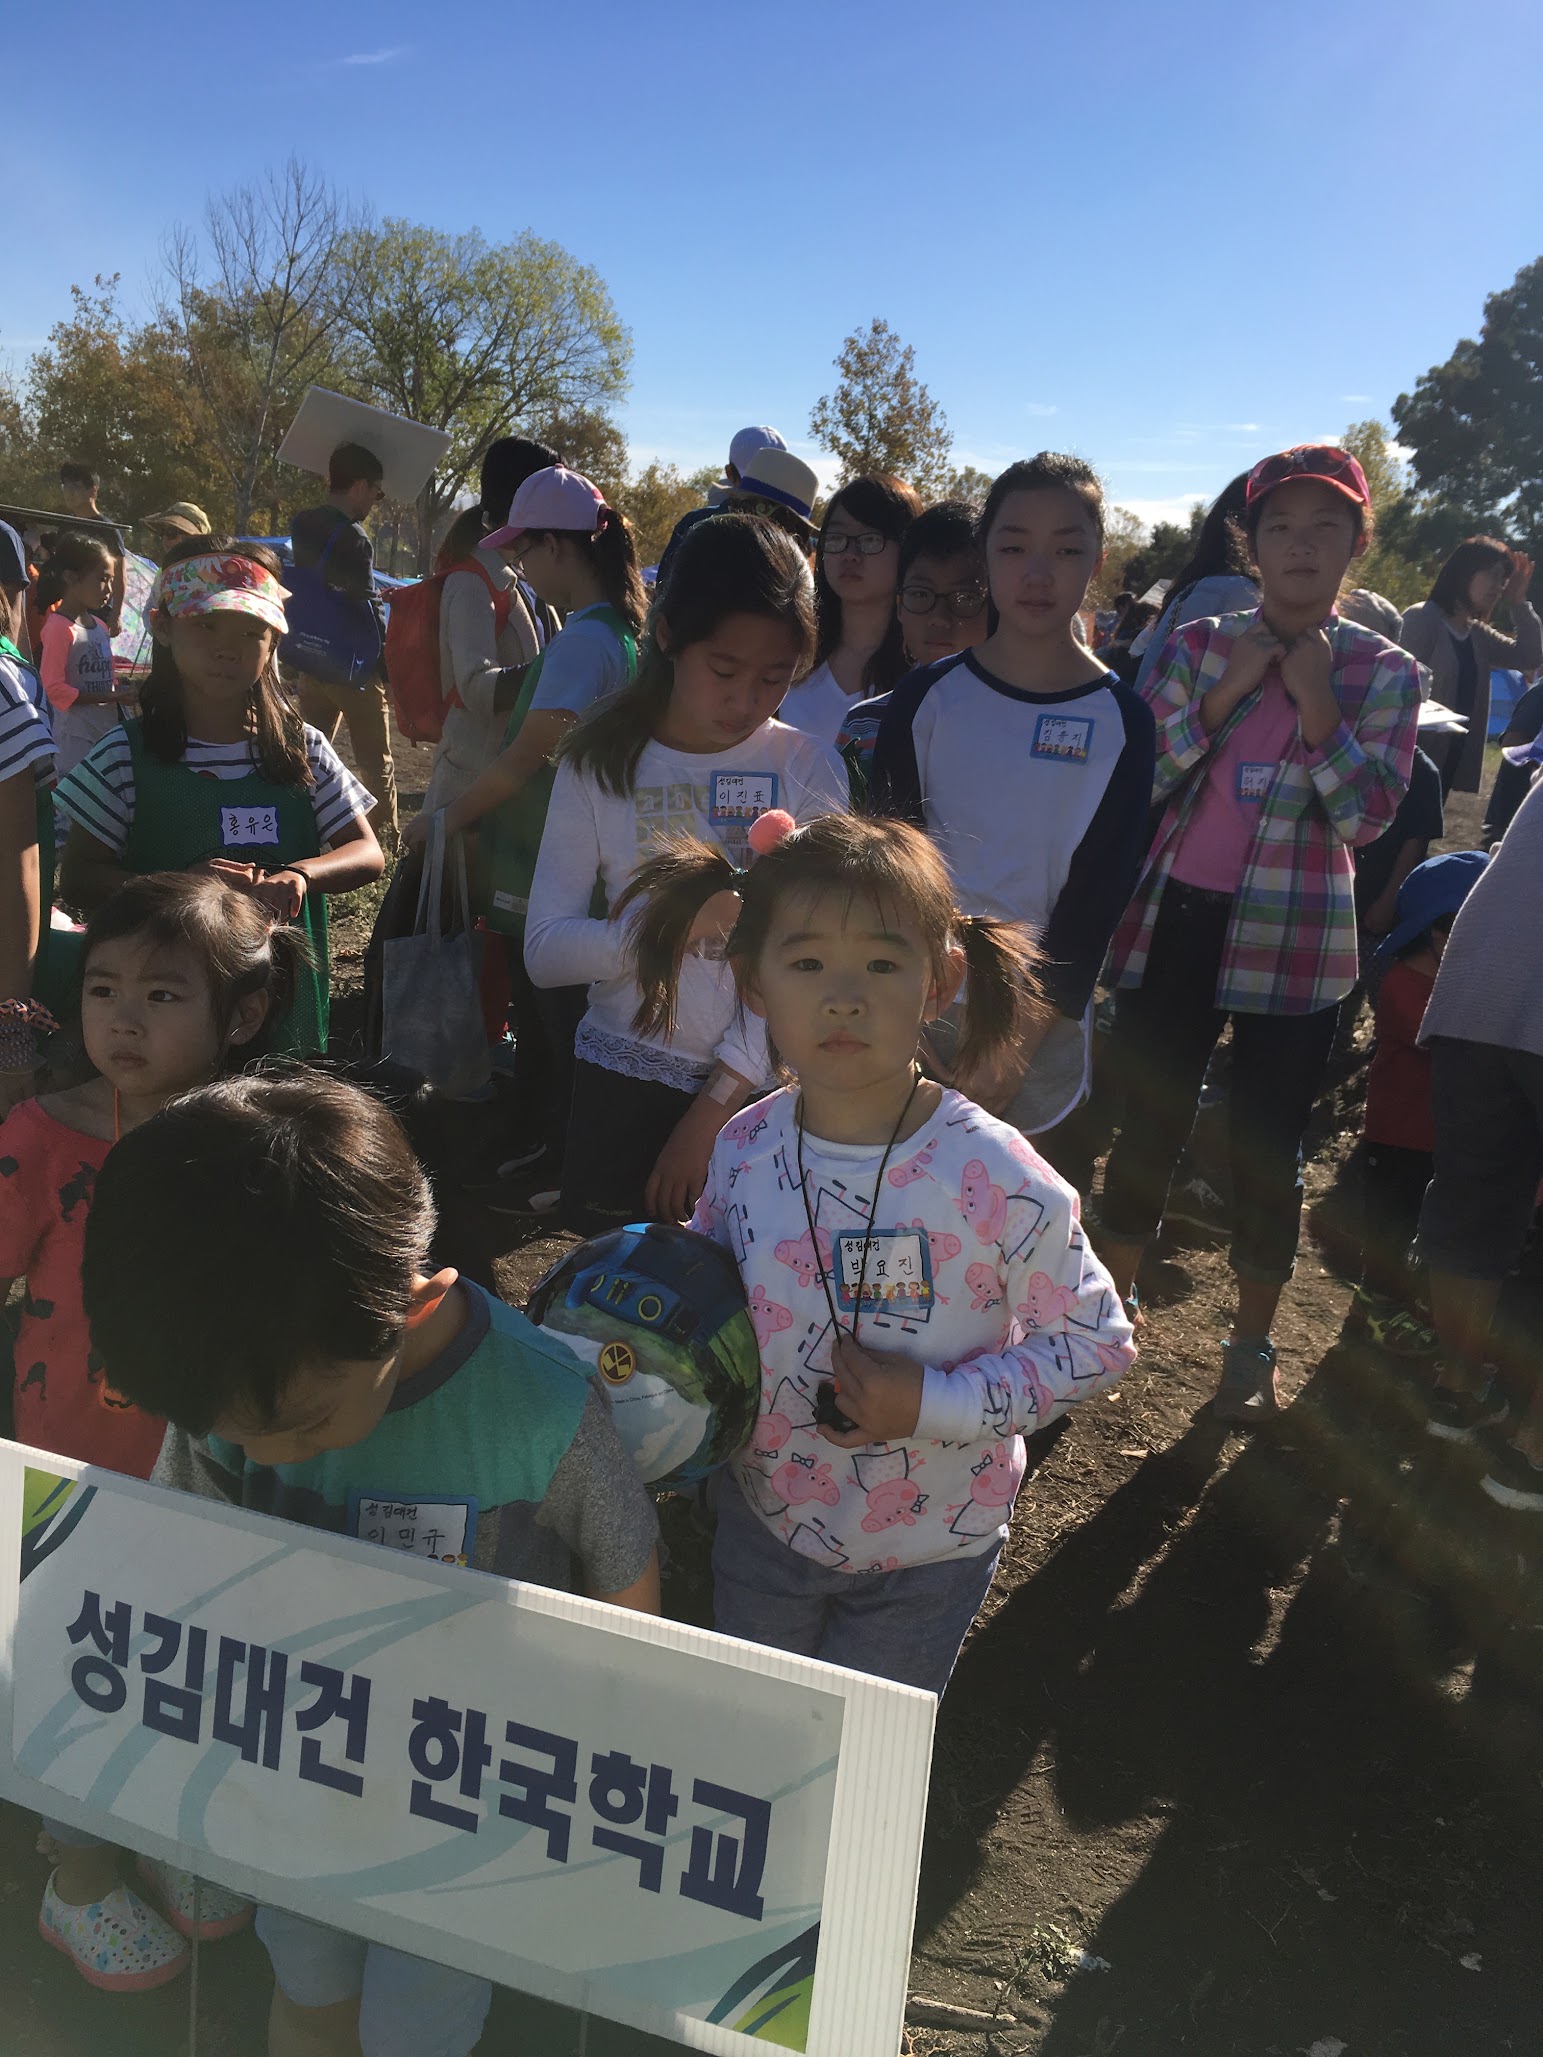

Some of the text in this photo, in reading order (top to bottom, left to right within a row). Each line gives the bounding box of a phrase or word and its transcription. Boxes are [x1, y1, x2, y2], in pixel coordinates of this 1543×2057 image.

[366, 1502, 418, 1520] 성김대건
[67, 1589, 772, 1921] 성김대건 한국학교
